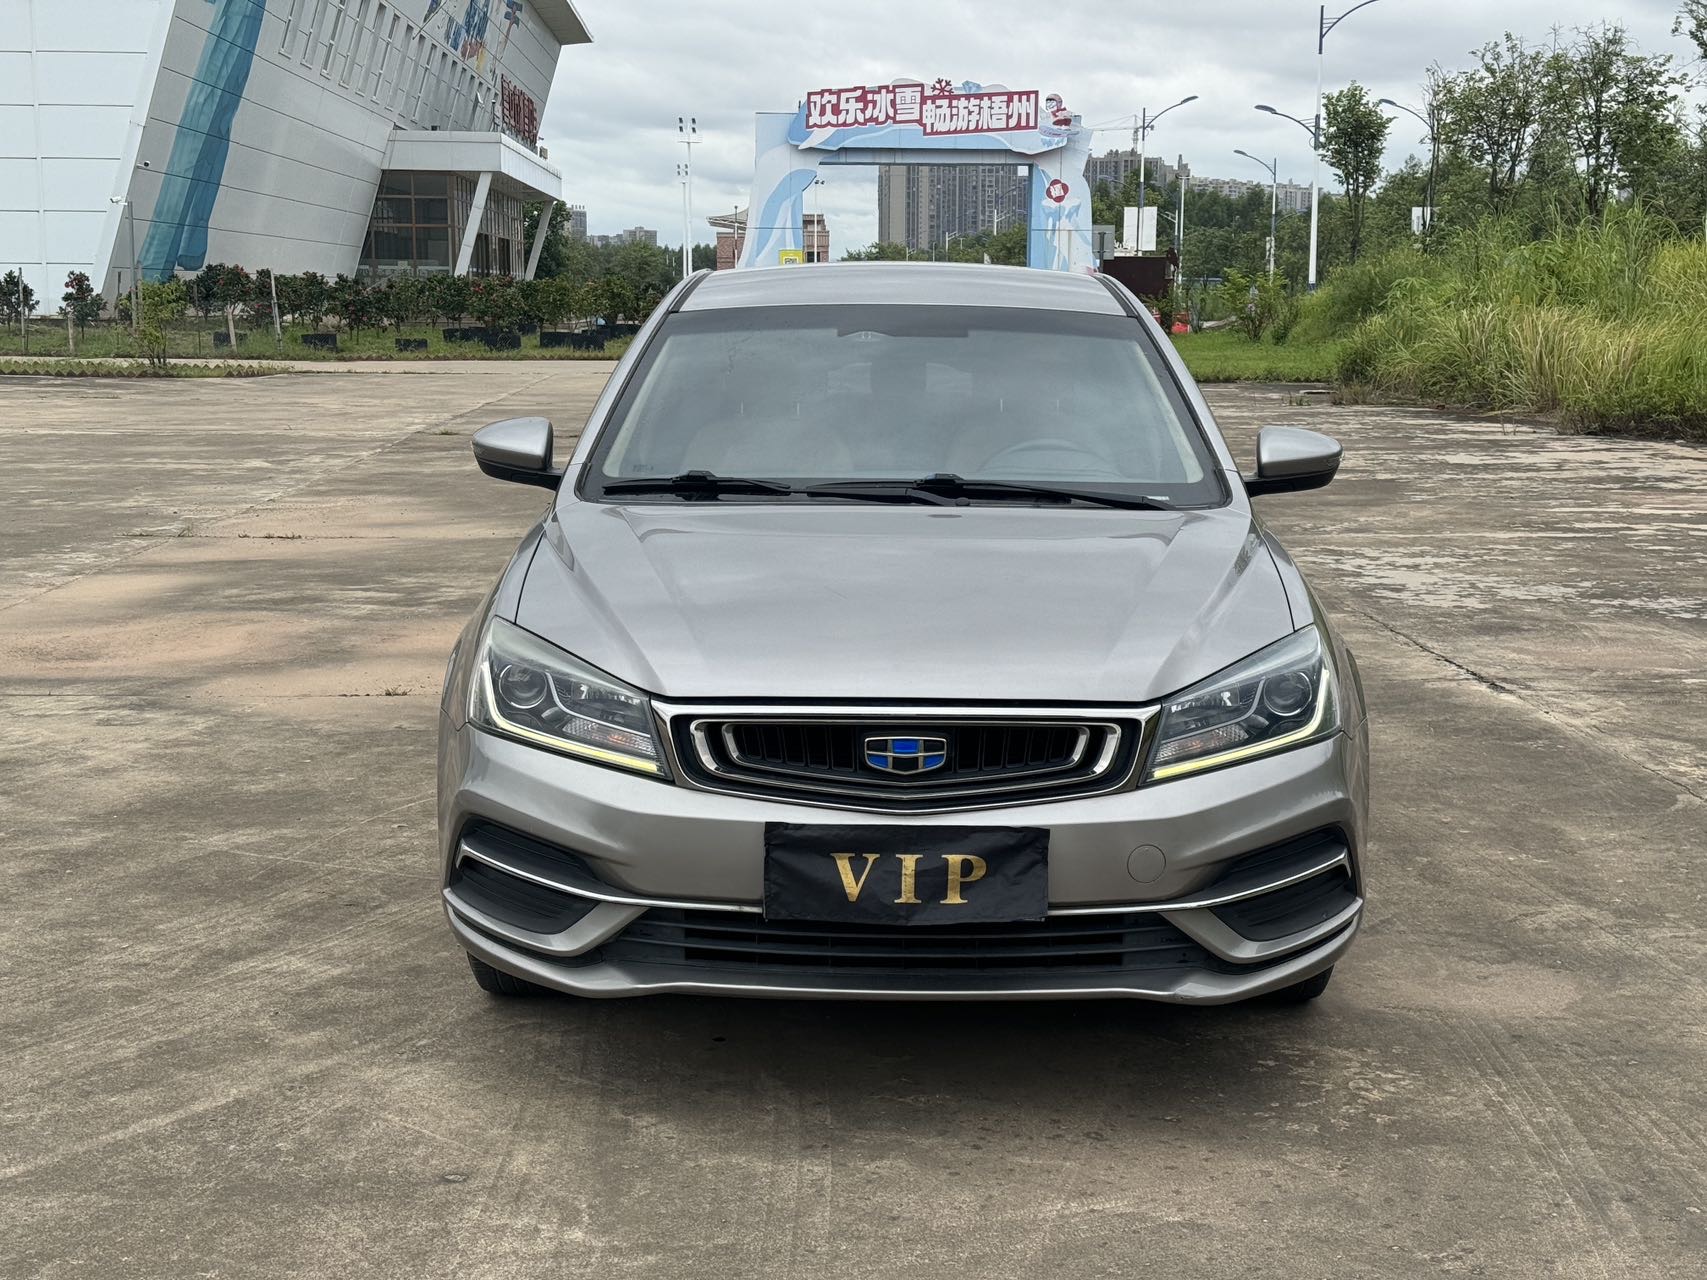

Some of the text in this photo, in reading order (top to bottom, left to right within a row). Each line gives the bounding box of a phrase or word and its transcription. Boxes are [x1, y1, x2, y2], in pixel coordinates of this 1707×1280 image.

[808, 87, 1038, 132] 欢乐冰雪 畅游梧州
[830, 852, 987, 904] VIP
